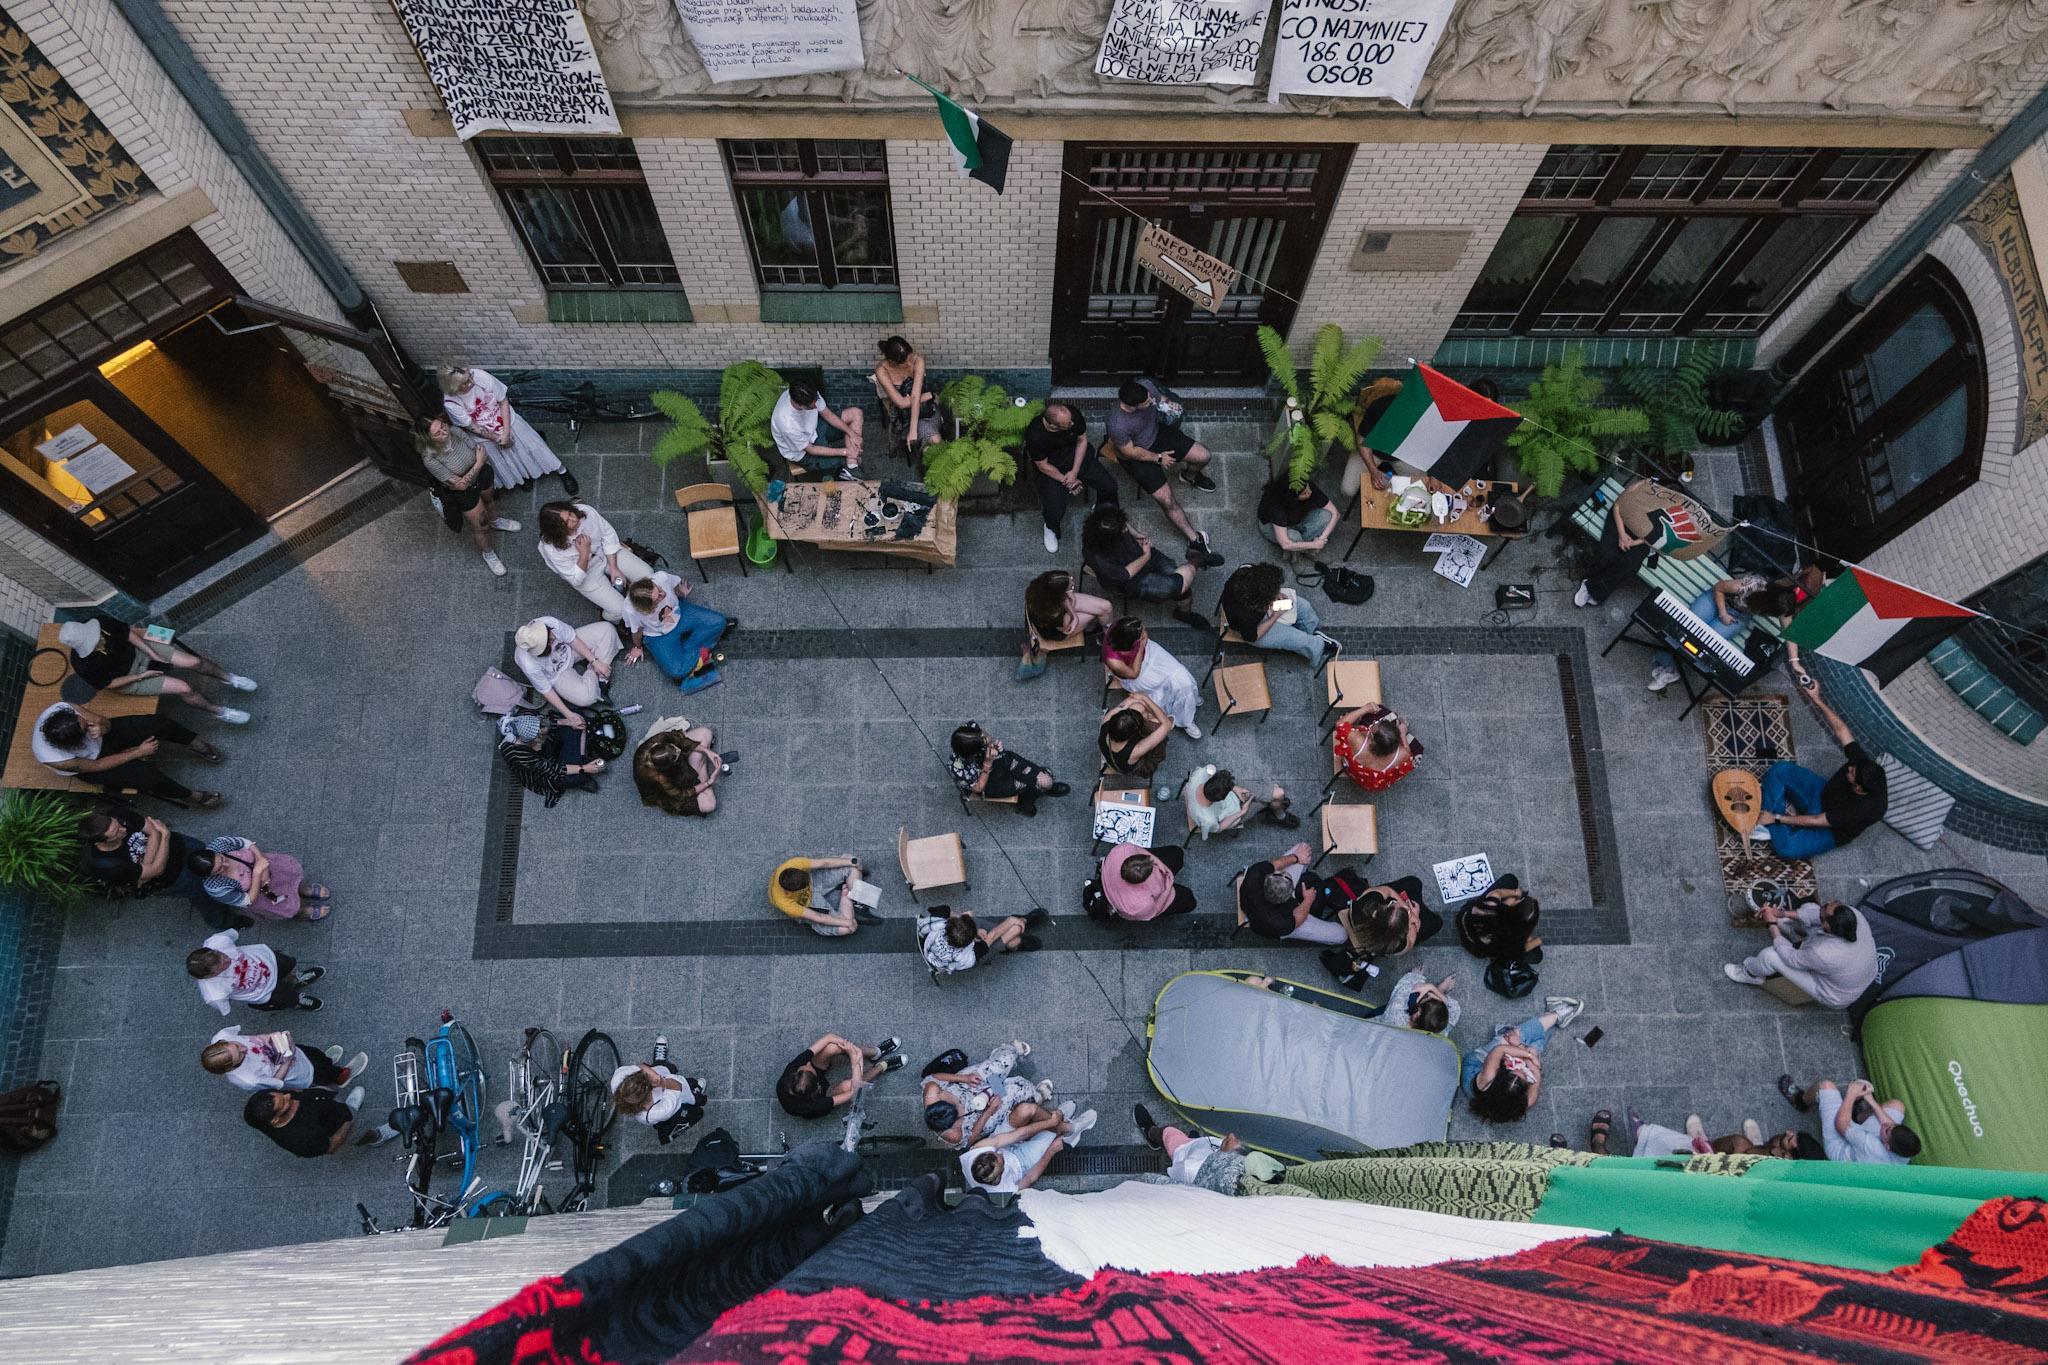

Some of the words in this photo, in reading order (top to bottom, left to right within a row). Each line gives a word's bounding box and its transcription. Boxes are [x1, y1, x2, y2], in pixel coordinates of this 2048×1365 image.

[1282, 16, 1318, 39] CO
[1321, 18, 1428, 43] NAJMNIEJ
[1106, 33, 1143, 57] NIKT
[1148, 51, 1161, 62] W
[1165, 52, 1196, 64] TYM
[1101, 57, 1124, 76] DO
[1126, 65, 1201, 83] EDUKACJI
[1146, 63, 1171, 75] NIE
[1173, 64, 1196, 75] MA
[1307, 61, 1374, 86] OSÓB
[1152, 230, 1188, 256] INFO
[1139, 256, 1177, 285] ROOM
